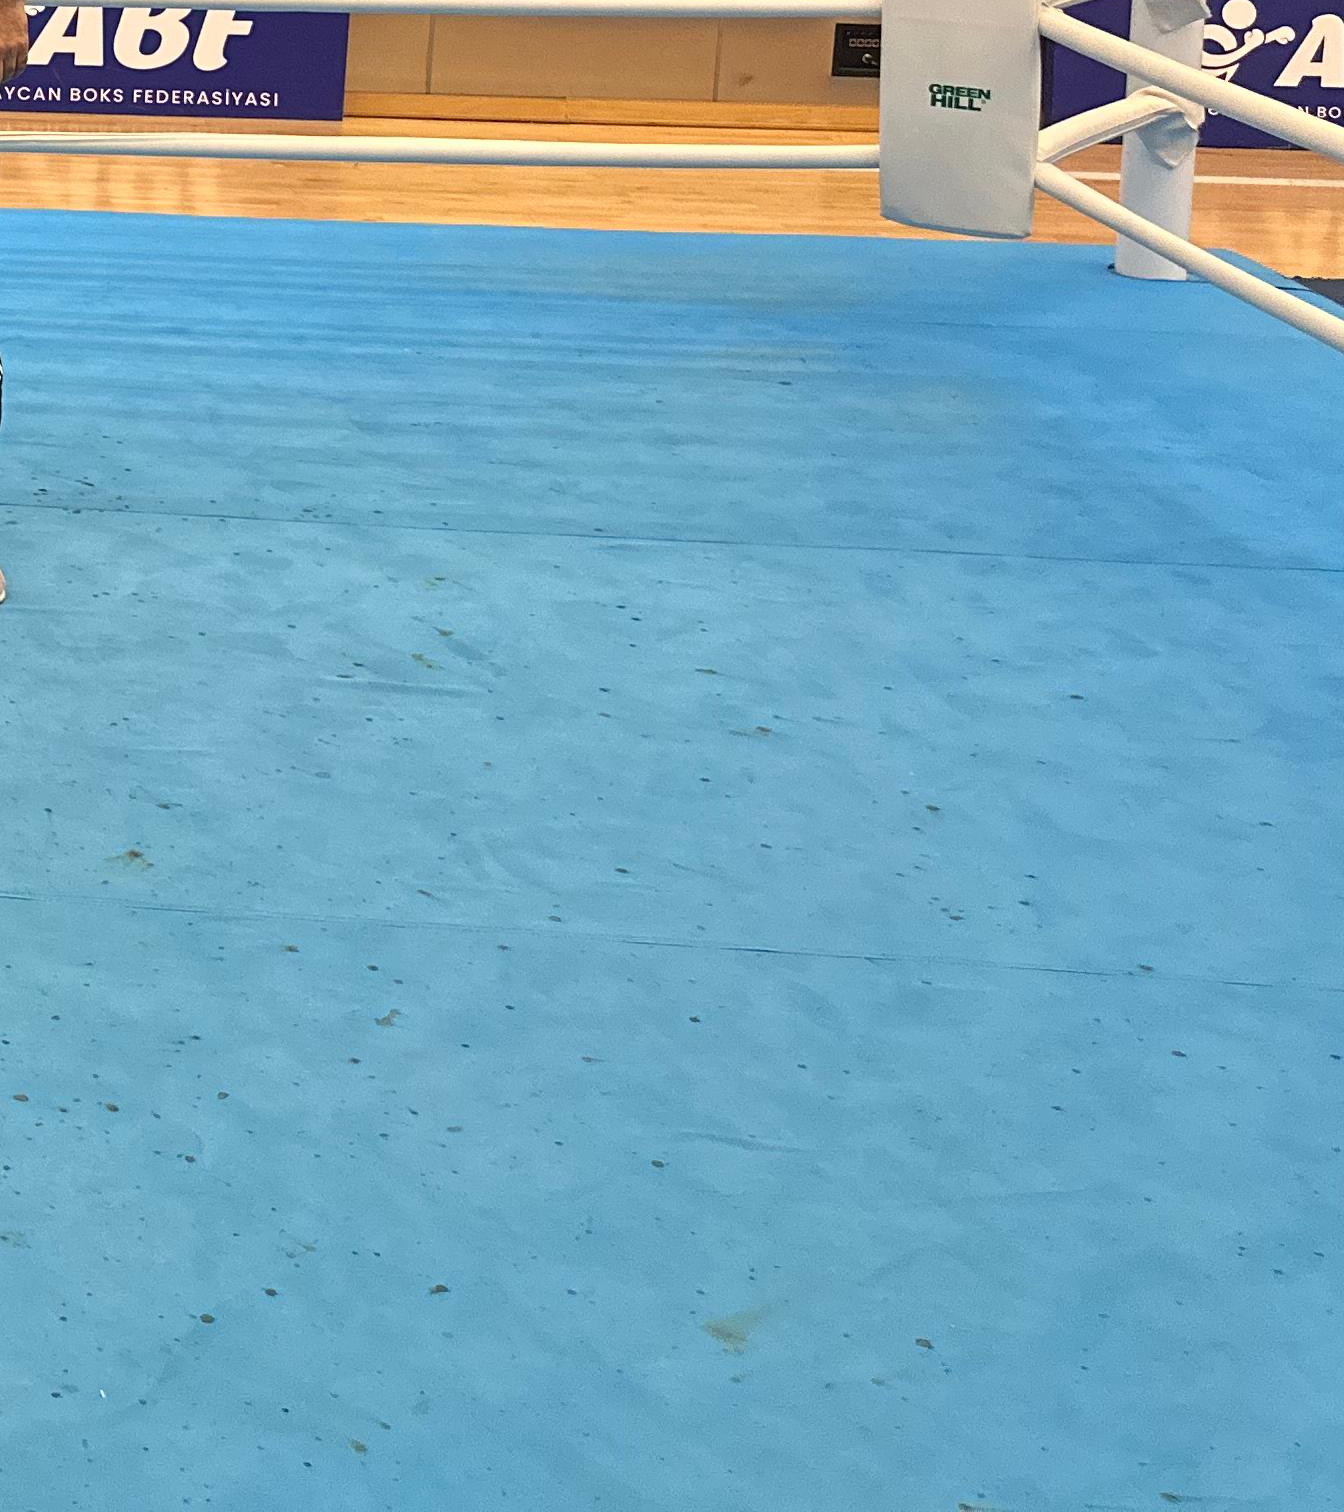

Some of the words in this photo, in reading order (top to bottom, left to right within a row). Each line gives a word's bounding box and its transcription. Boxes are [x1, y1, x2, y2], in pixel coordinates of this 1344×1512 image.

[70, 87, 124, 103] BOKS
[133, 88, 279, 107] FEDERASİYASI
[928, 83, 992, 100] GREEN
[930, 95, 982, 111] HILL
